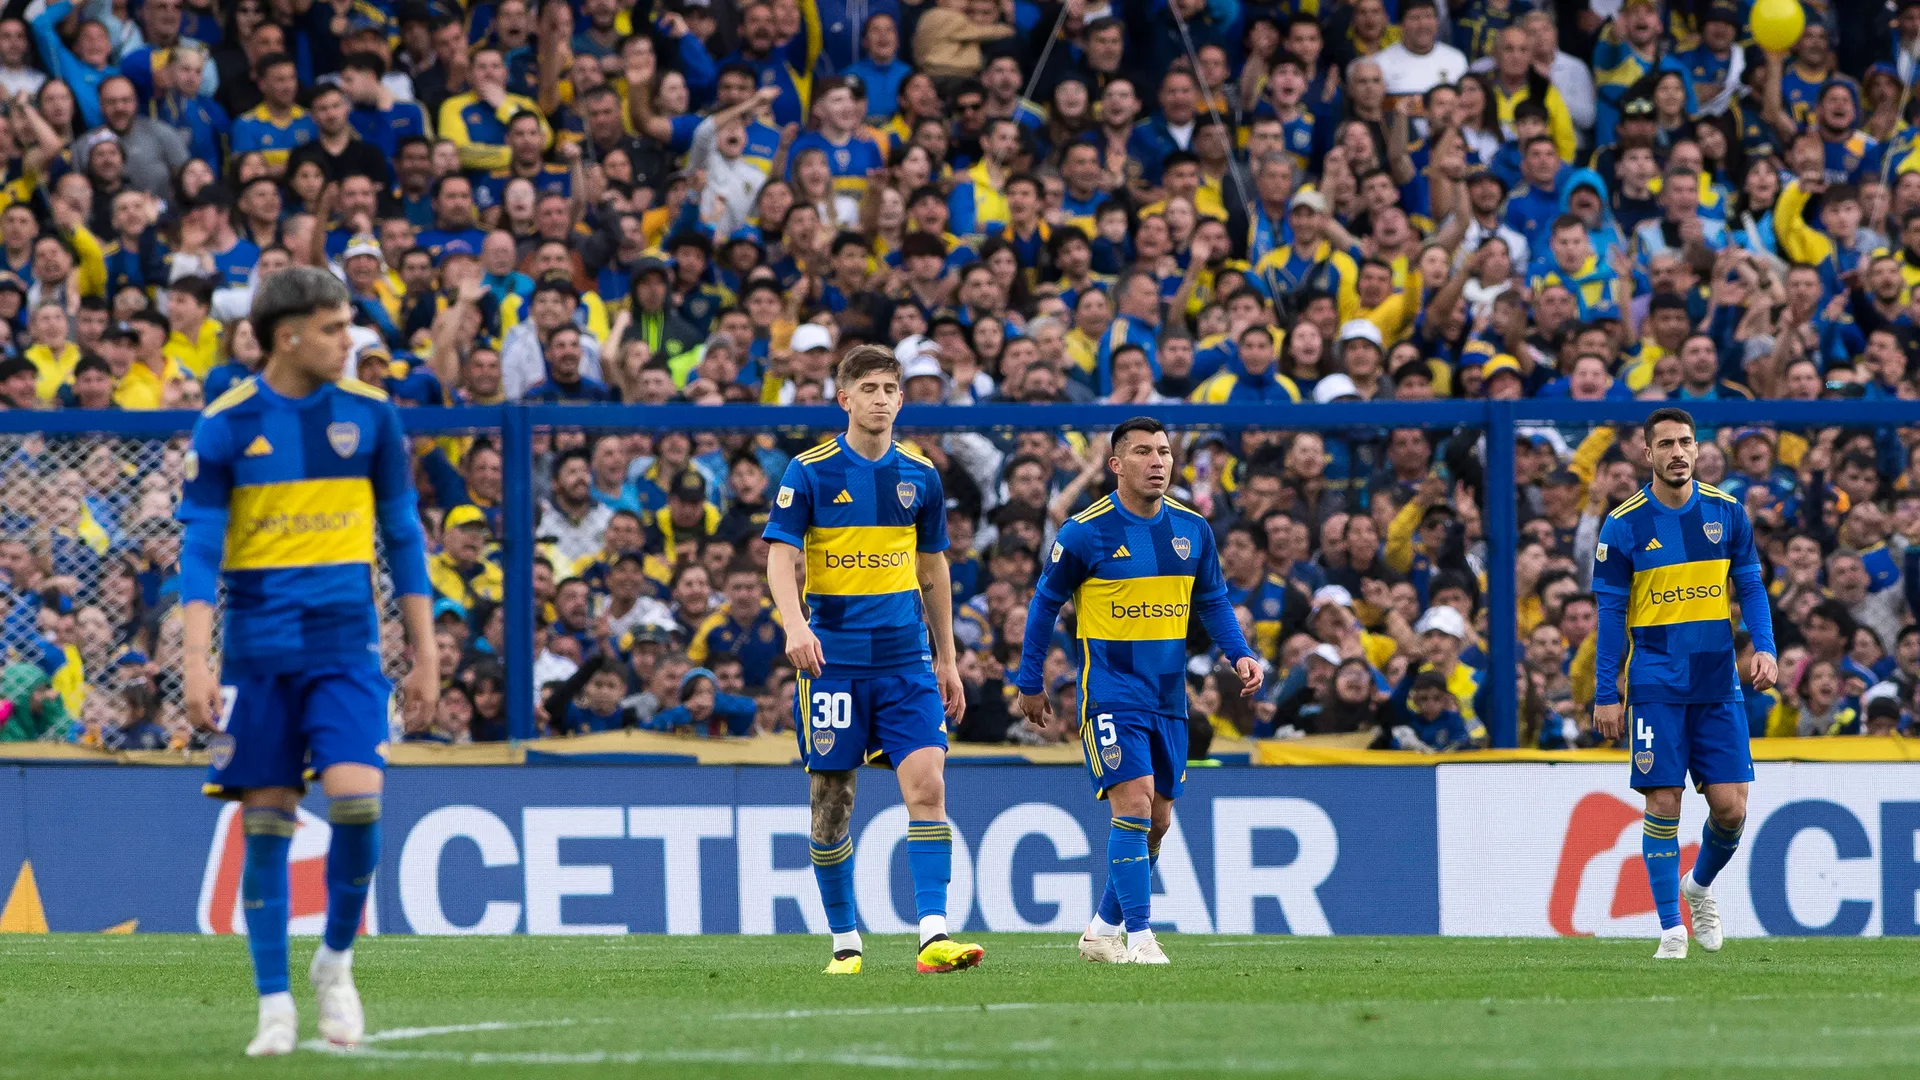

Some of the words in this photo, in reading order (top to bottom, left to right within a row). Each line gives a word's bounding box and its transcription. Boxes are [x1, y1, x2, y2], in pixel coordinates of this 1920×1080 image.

[825, 549, 910, 569] betsson
[1650, 584, 1724, 605] betsso
[812, 691, 852, 729] 30
[1097, 712, 1117, 746] 5
[1637, 717, 1654, 749] 4
[398, 796, 1339, 937] CETROGAR
